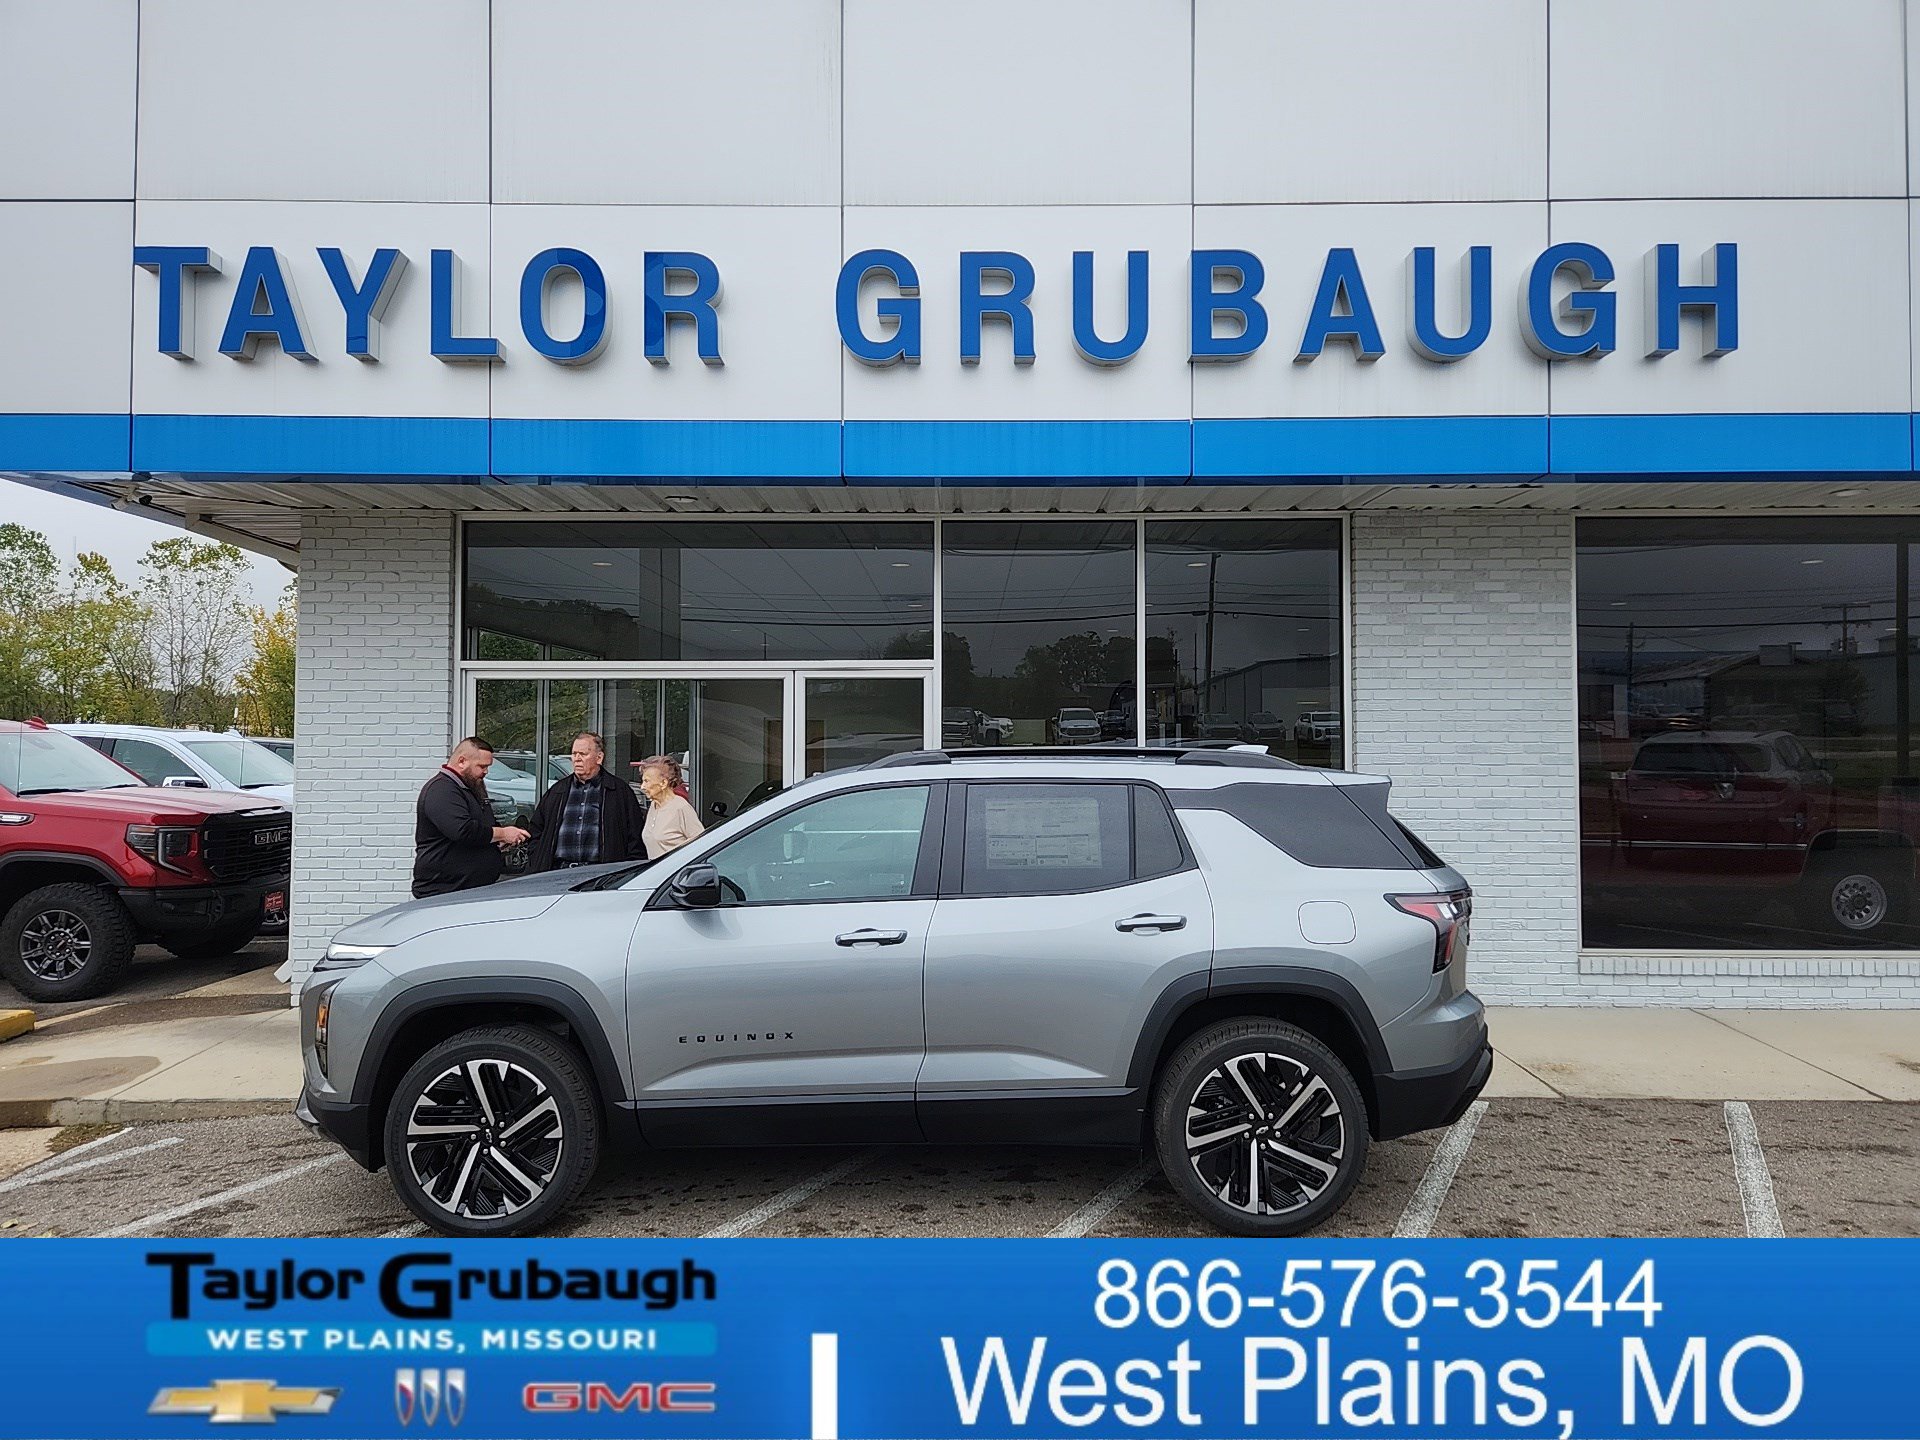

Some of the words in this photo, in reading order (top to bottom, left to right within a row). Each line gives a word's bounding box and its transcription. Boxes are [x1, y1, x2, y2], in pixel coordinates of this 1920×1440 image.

[133, 246, 726, 366] TAYLOR
[835, 242, 1739, 367] GRUBAUGH
[255, 830, 289, 844] GMC
[678, 1031, 794, 1044] EQUINOX
